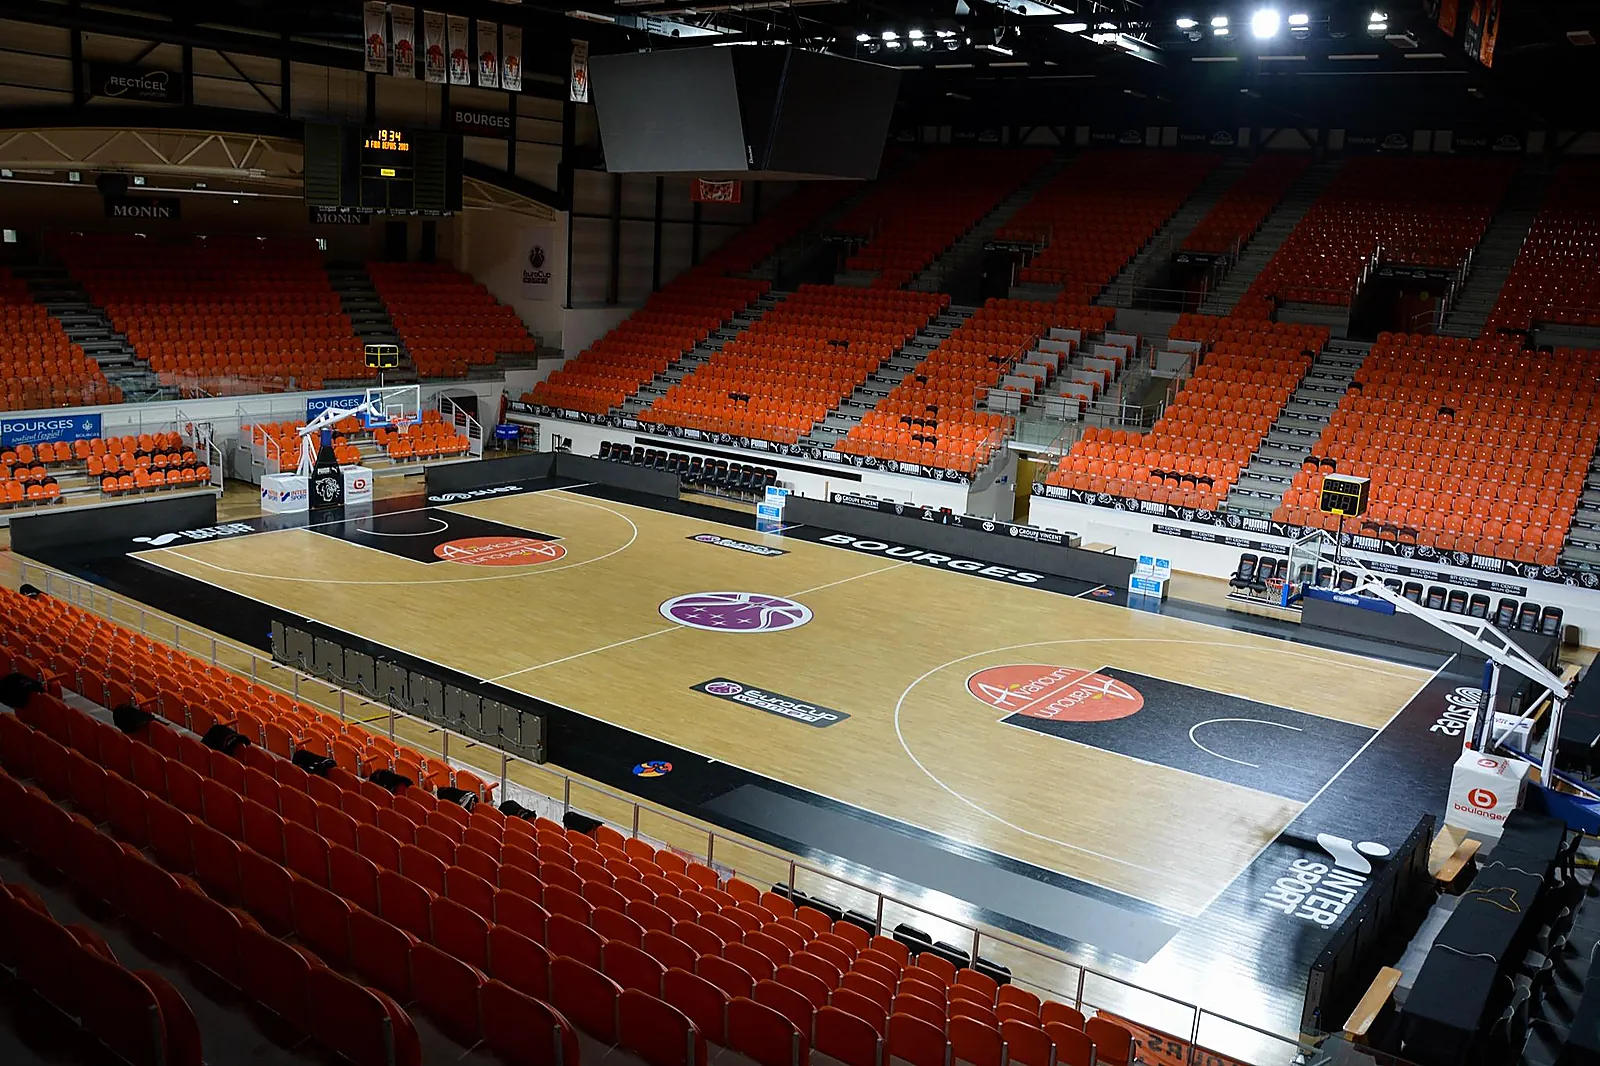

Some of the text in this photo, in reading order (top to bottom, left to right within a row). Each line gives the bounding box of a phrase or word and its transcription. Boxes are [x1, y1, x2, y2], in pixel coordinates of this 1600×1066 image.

[110, 76, 167, 91] RECTICEL
[455, 111, 511, 129] BOURGES
[112, 204, 171, 218] MONIN
[316, 213, 361, 224] MONIN
[308, 399, 359, 410] BOURGES
[3, 419, 74, 433] BOURGES
[822, 450, 841, 460] PUMA
[900, 462, 919, 473] PUMA
[1046, 485, 1068, 496] PUMA
[843, 495, 860, 504] GROUPE
[860, 499, 879, 507] VINCENT
[1141, 501, 1164, 512] PUMA
[1243, 518, 1269, 530] PUMA
[1019, 528, 1039, 537] GROUPE
[1039, 532, 1062, 541] VINCENT
[1352, 535, 1380, 549] PUMA
[818, 533, 1045, 584] BOURGES
[1471, 555, 1501, 568] PUMA
[976, 668, 1076, 706] Avaricum
[1033, 677, 1136, 718] Avaricum
[744, 689, 839, 721] EuroCup
[1454, 803, 1507, 822] boulanger
[1260, 858, 1329, 915] SPORT
[1295, 868, 1368, 925] INTER
